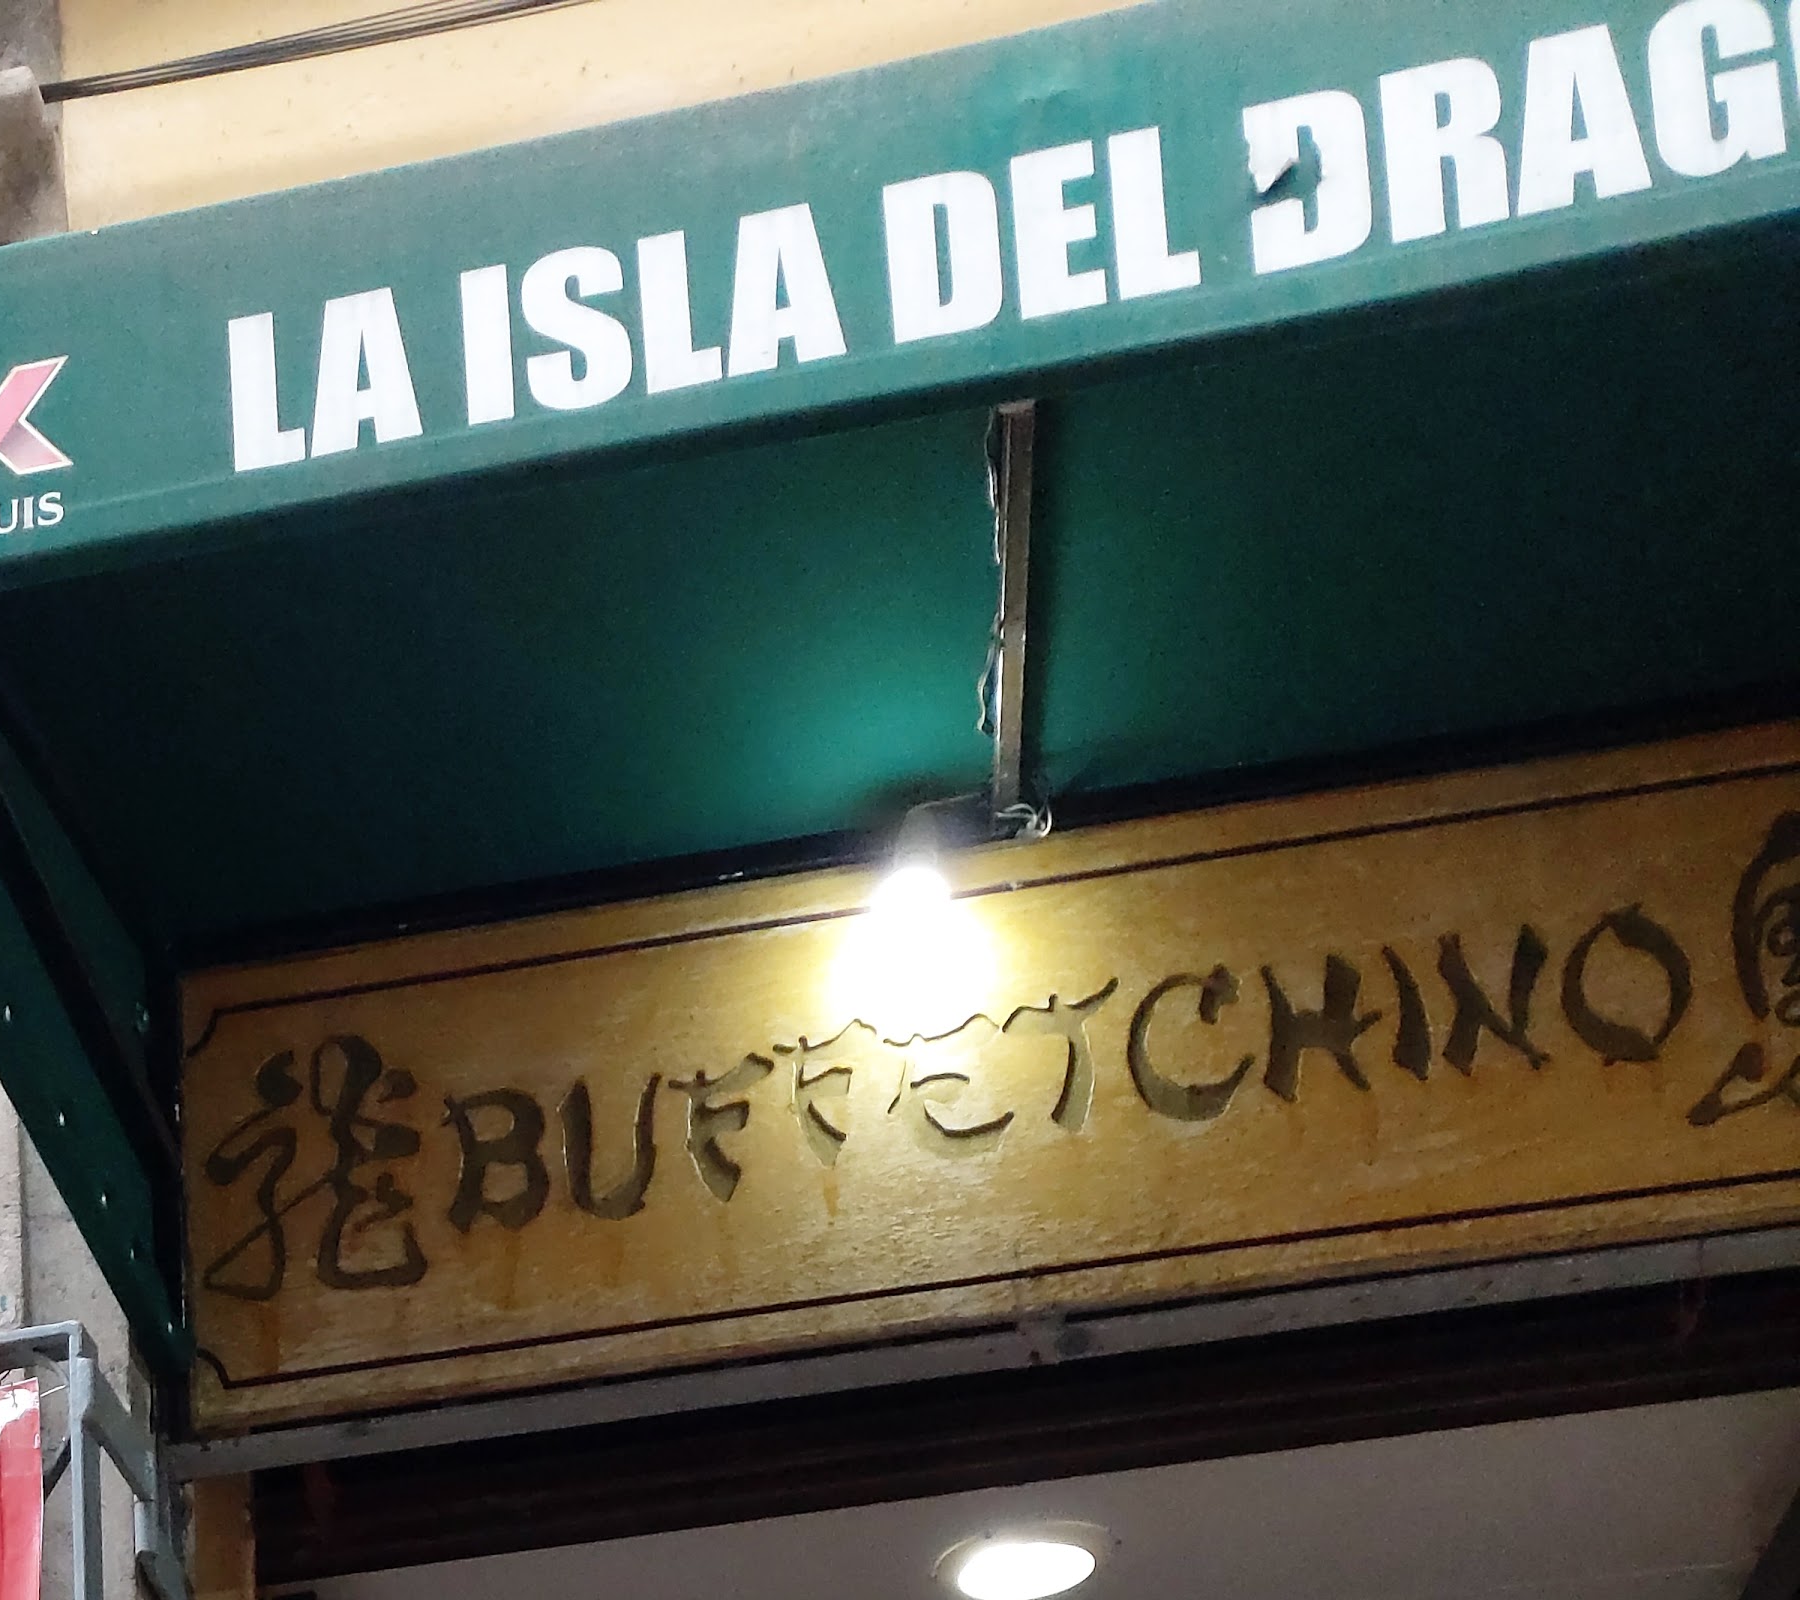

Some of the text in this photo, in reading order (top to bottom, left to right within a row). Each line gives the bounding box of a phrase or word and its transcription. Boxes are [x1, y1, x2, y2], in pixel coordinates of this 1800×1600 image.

[227, 0, 1800, 473] LA ISLA DEL DRAG
[1126, 901, 1694, 1123] CHINO
